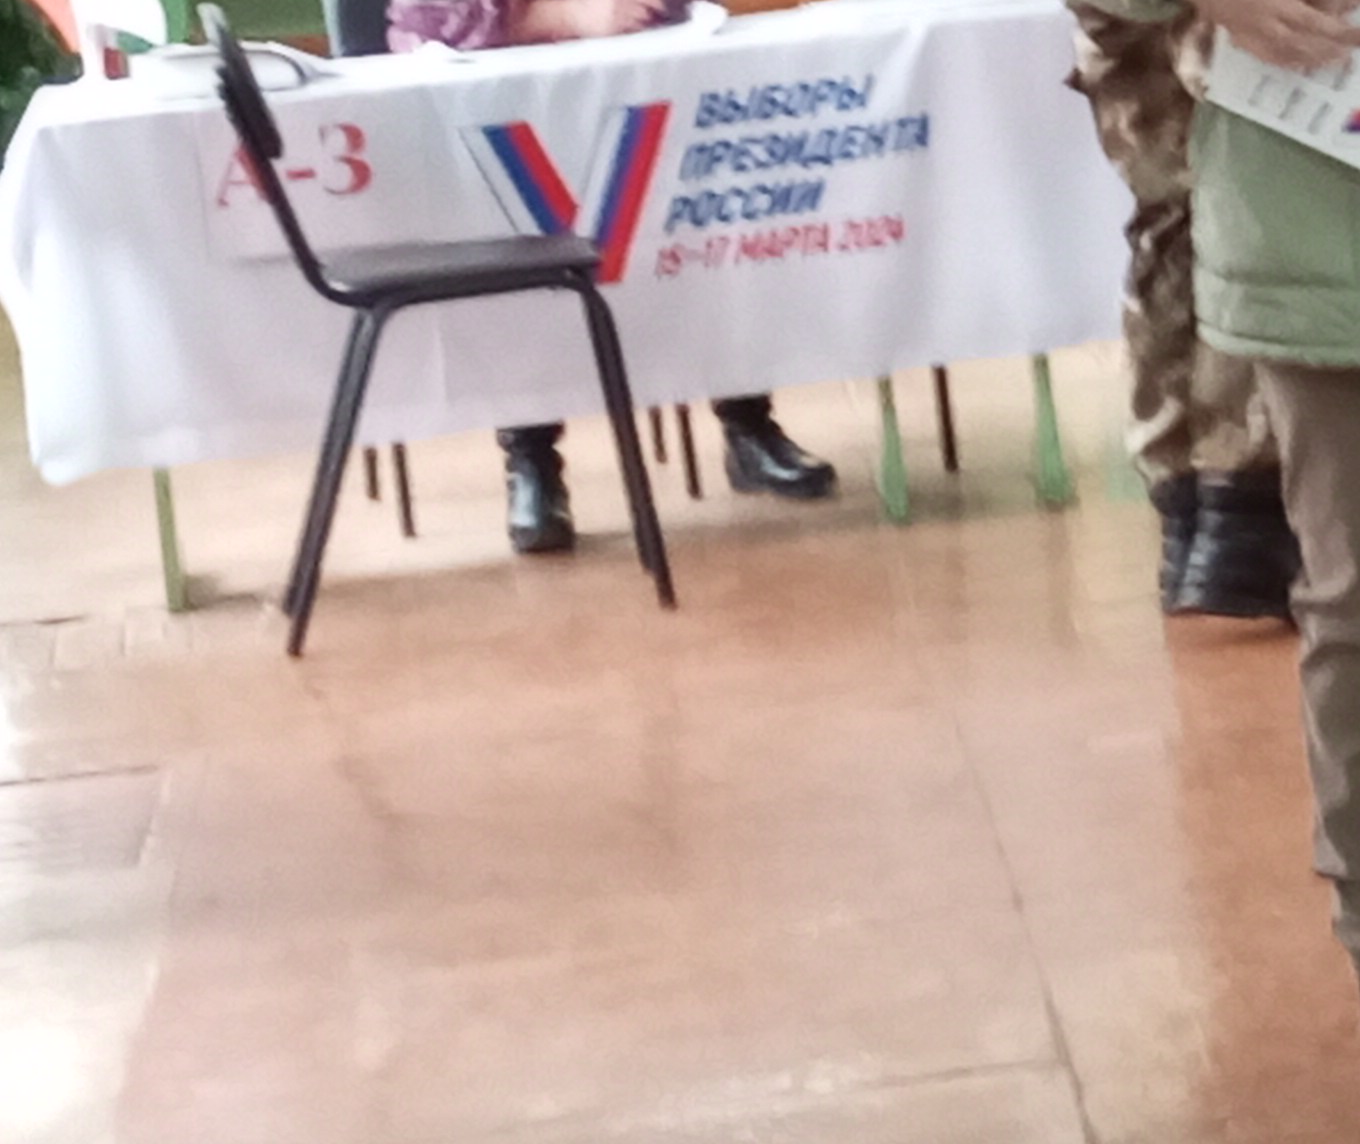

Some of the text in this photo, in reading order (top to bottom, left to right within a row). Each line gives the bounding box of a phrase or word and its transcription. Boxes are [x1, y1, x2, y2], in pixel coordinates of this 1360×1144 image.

[694, 73, 874, 129] ВЫБОРЫ
[679, 110, 930, 181] ПРЕЗИДЕНТА
[663, 178, 827, 235] РОССИИ
[735, 222, 829, 264] МАРТА
[838, 213, 905, 252] 2024
